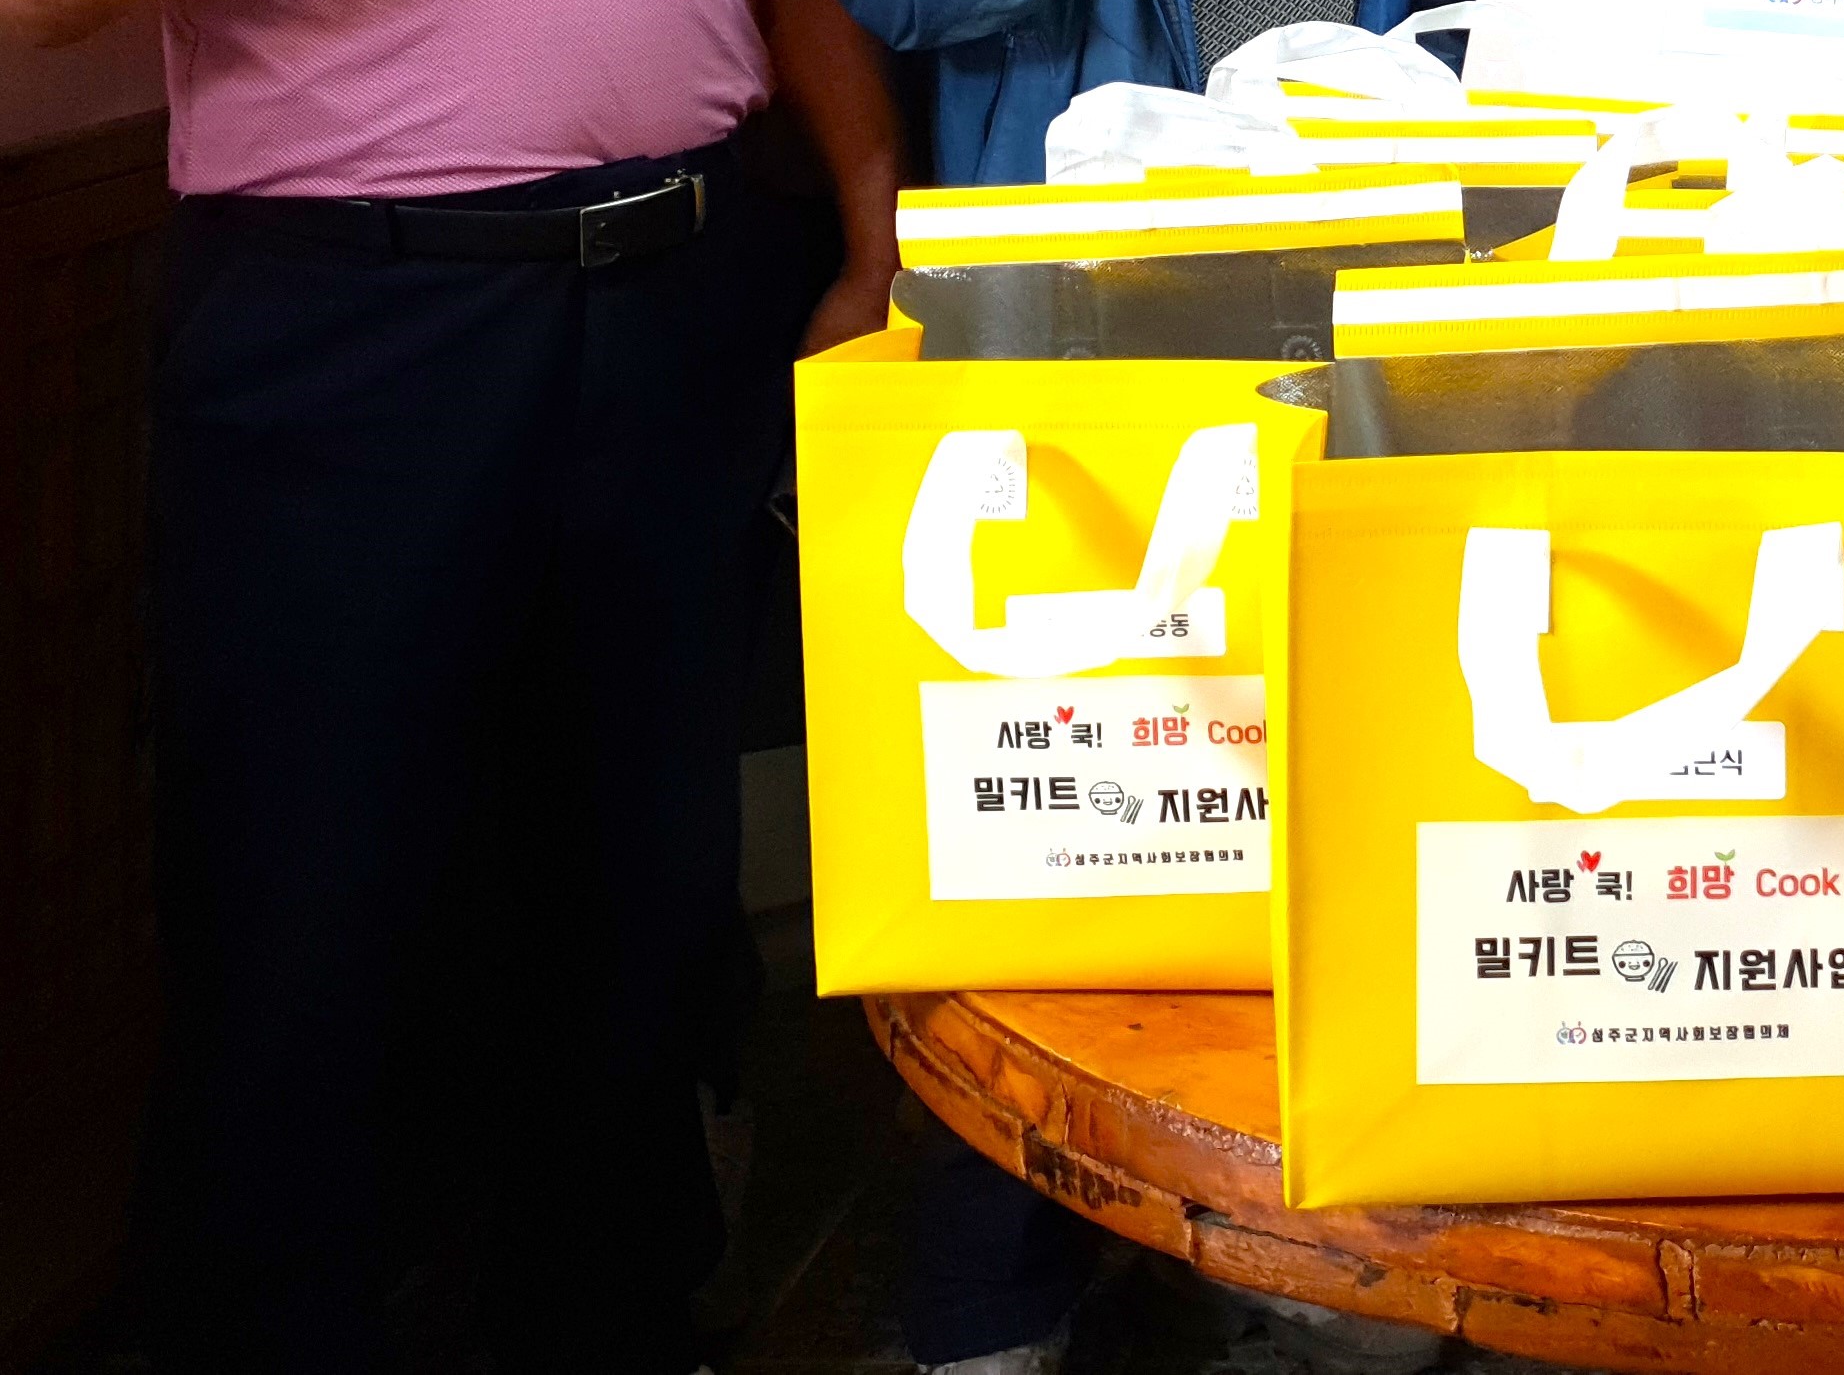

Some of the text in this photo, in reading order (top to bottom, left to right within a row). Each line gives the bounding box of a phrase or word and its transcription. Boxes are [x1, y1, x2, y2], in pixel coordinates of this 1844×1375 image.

[997, 721, 1052, 749] 사랑
[1070, 722, 1103, 748] 쿡!
[1132, 716, 1190, 747] 희망
[1669, 749, 1743, 776] 근식
[974, 776, 1080, 812] 밀키트
[1506, 864, 1841, 904] 사랑 쿡! 희망 Cook
[1474, 936, 1601, 980] 밀키트
